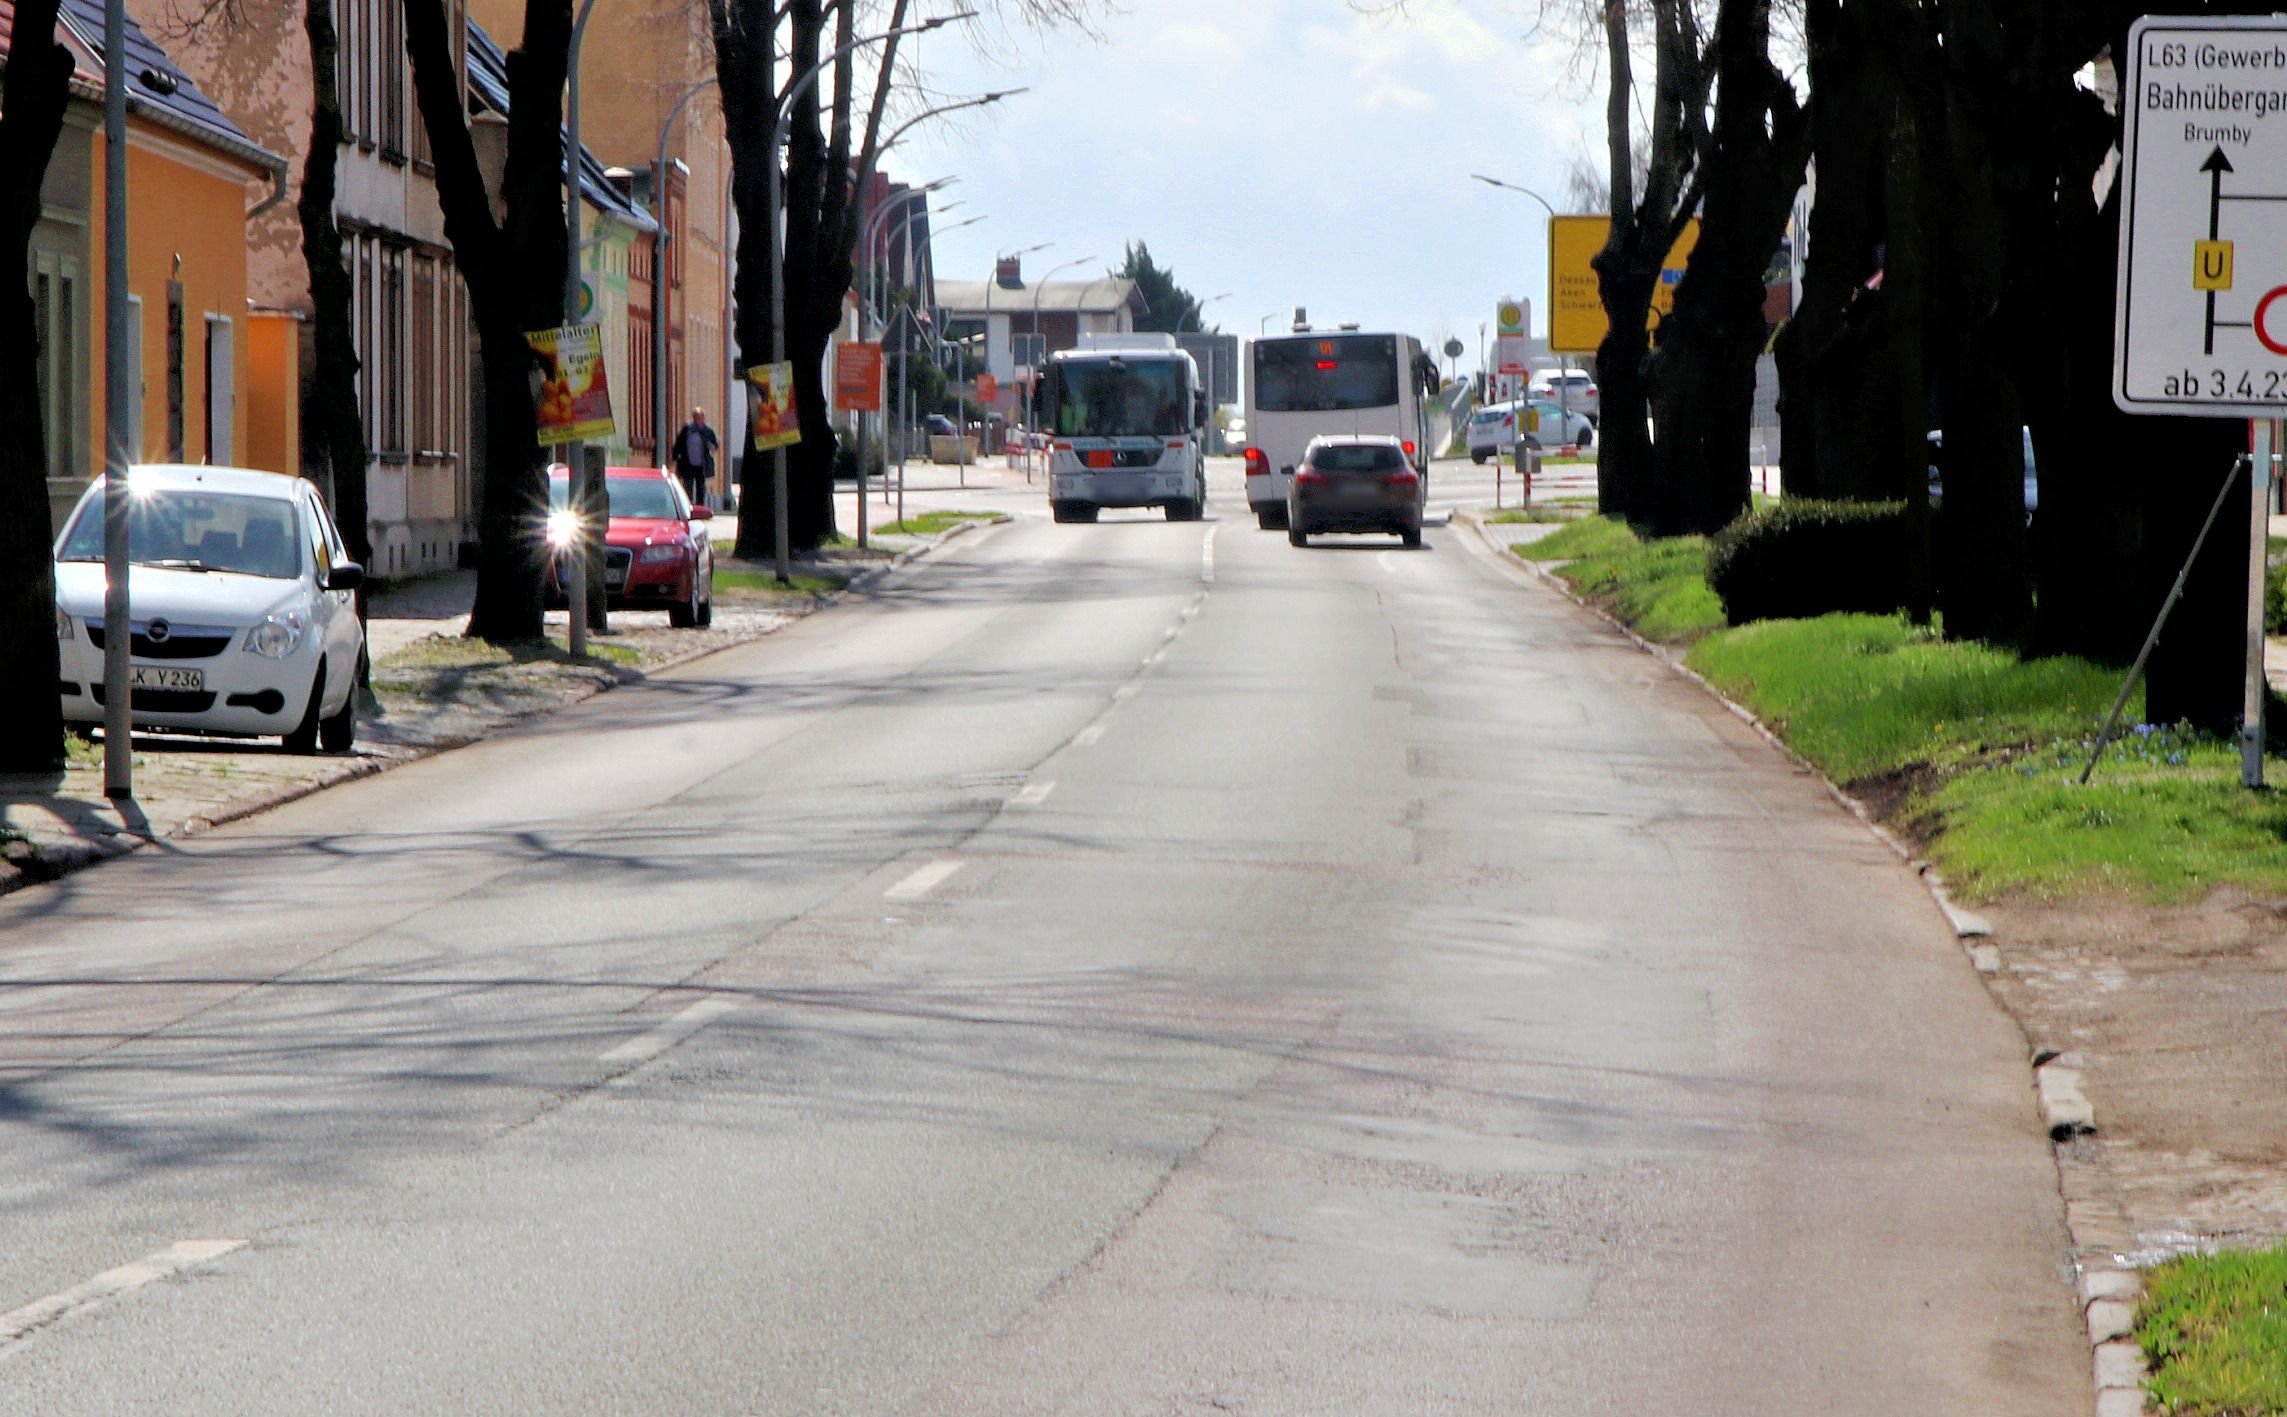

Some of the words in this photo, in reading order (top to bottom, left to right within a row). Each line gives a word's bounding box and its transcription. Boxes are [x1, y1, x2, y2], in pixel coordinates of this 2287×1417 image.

[2148, 43, 2186, 67] L63
[2194, 43, 2286, 71] (Gewerb
[2184, 122, 2251, 146] Brumby
[2204, 251, 2223, 279] U
[531, 325, 596, 344] Mittelalter
[2164, 369, 2199, 397] ab
